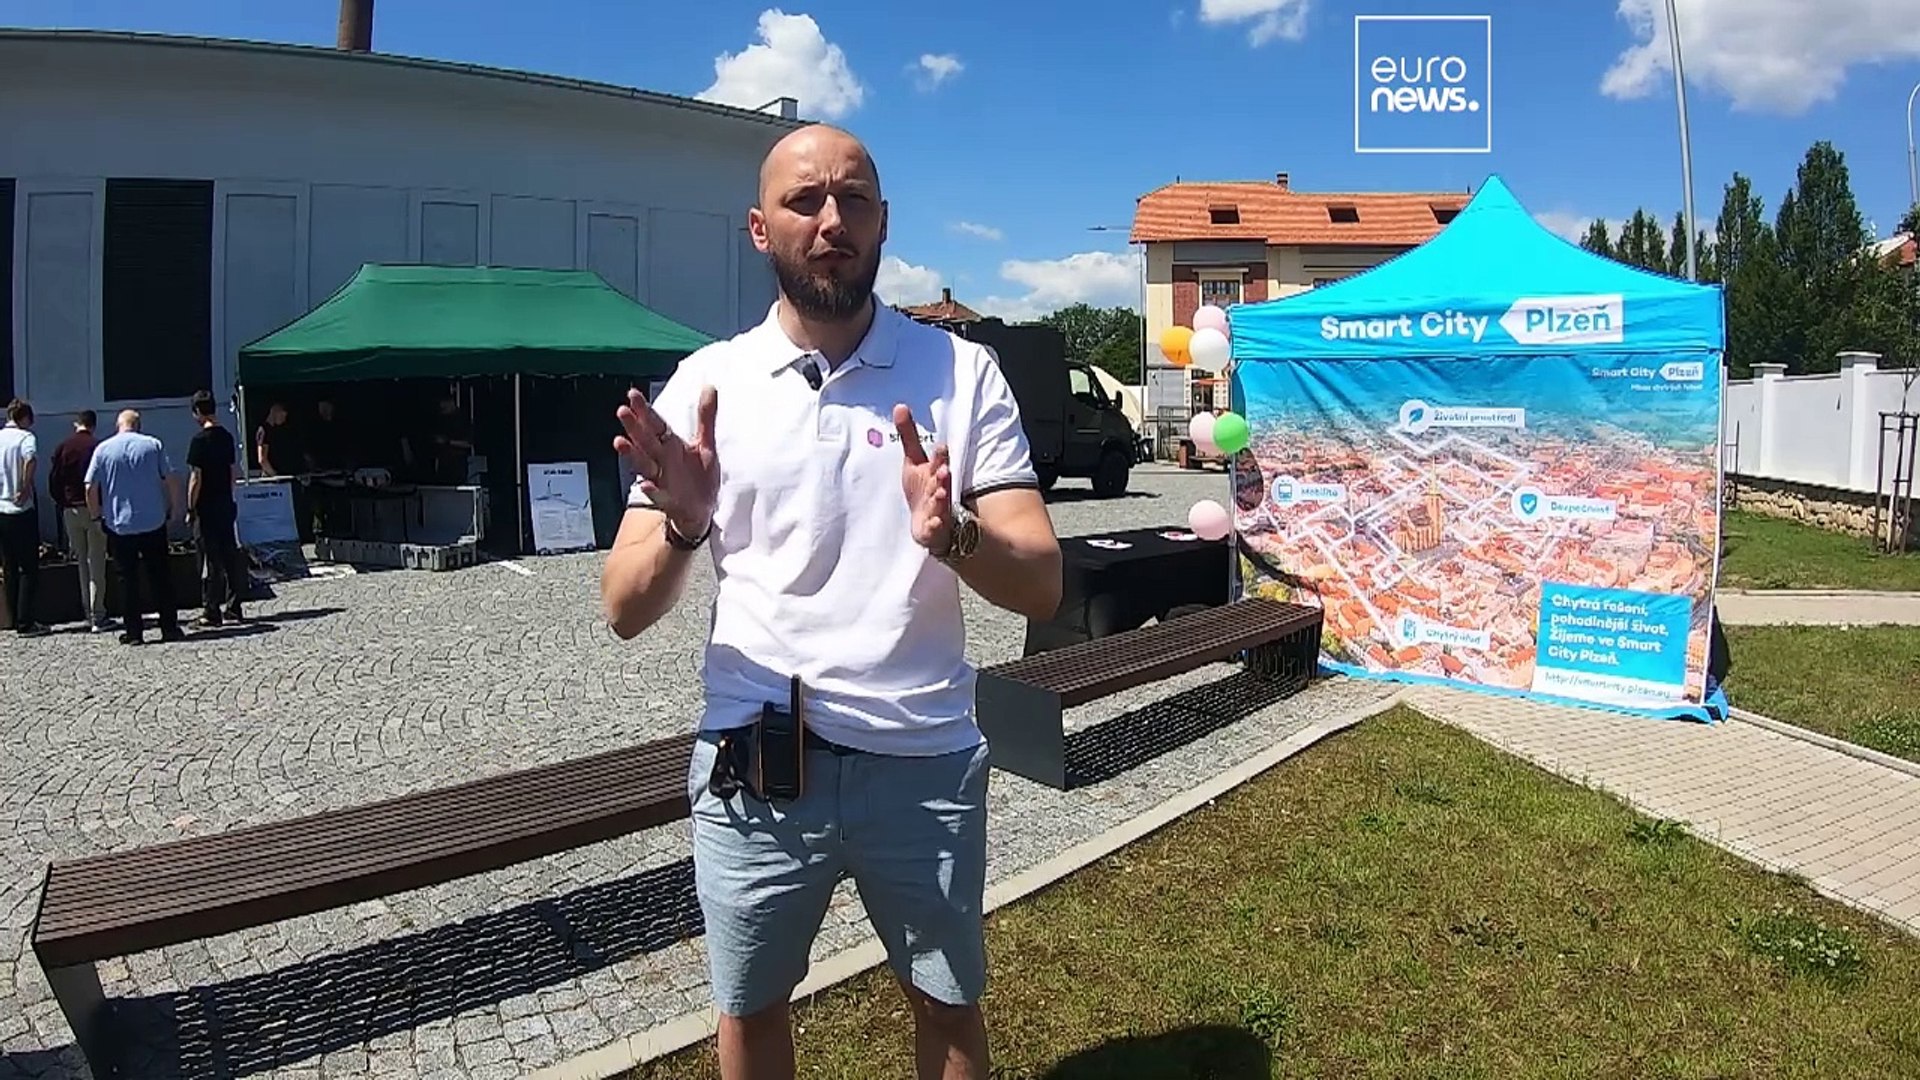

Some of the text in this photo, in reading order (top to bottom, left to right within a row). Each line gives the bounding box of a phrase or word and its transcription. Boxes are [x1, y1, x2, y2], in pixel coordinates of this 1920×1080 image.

[1320, 304, 1611, 343] Smart City Plzeň
[1591, 366, 1628, 378] Smart
[1630, 366, 1656, 379] City
[1551, 594, 1601, 611] Chytrá
[1549, 627, 1662, 652] Žijeme ve Smart
[1548, 645, 1578, 662] City
